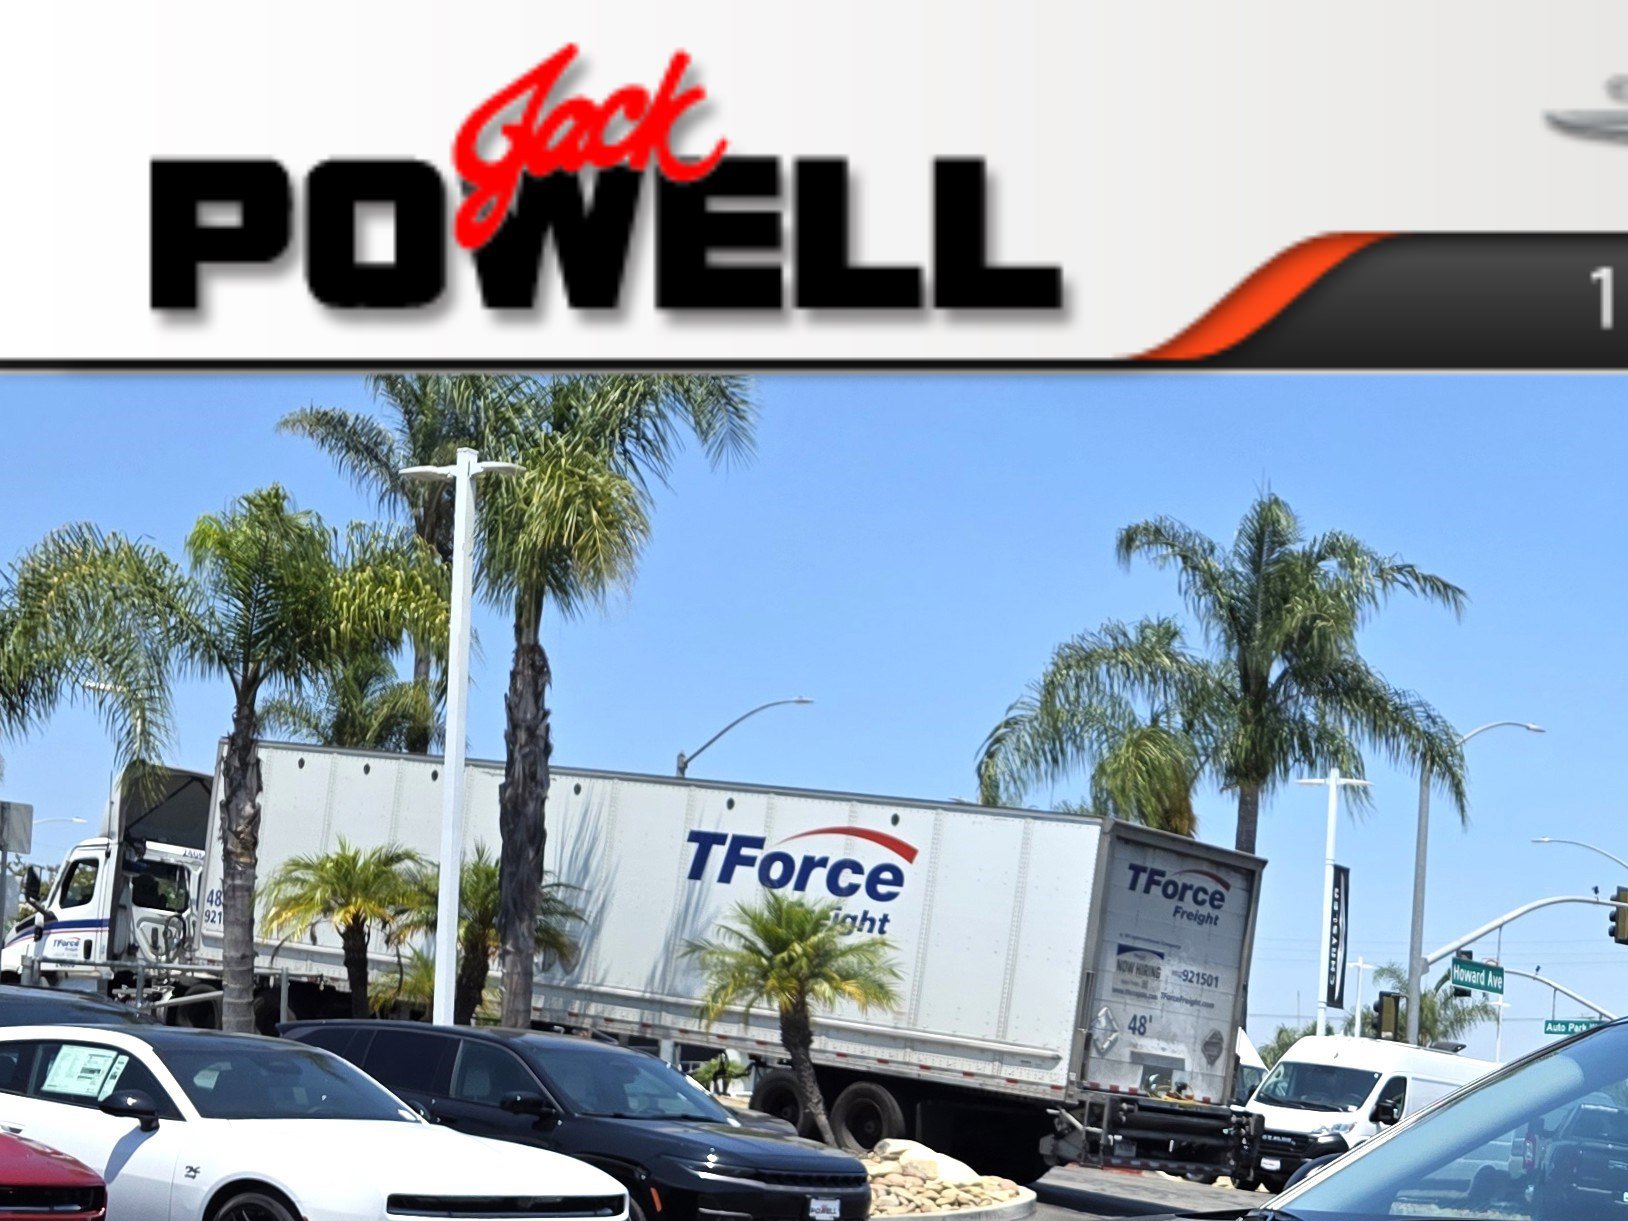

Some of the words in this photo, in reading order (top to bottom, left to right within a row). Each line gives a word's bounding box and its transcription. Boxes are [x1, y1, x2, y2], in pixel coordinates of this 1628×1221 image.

[687, 829, 905, 901] TForce
[1128, 863, 1225, 910] TForce
[1173, 905, 1220, 926] Freight
[1182, 968, 1220, 989] 921501
[1453, 965, 1485, 987] Howard
[1487, 973, 1503, 989] Ave
[1546, 1023, 1566, 1032] Auto
[1568, 1023, 1587, 1033] Park
